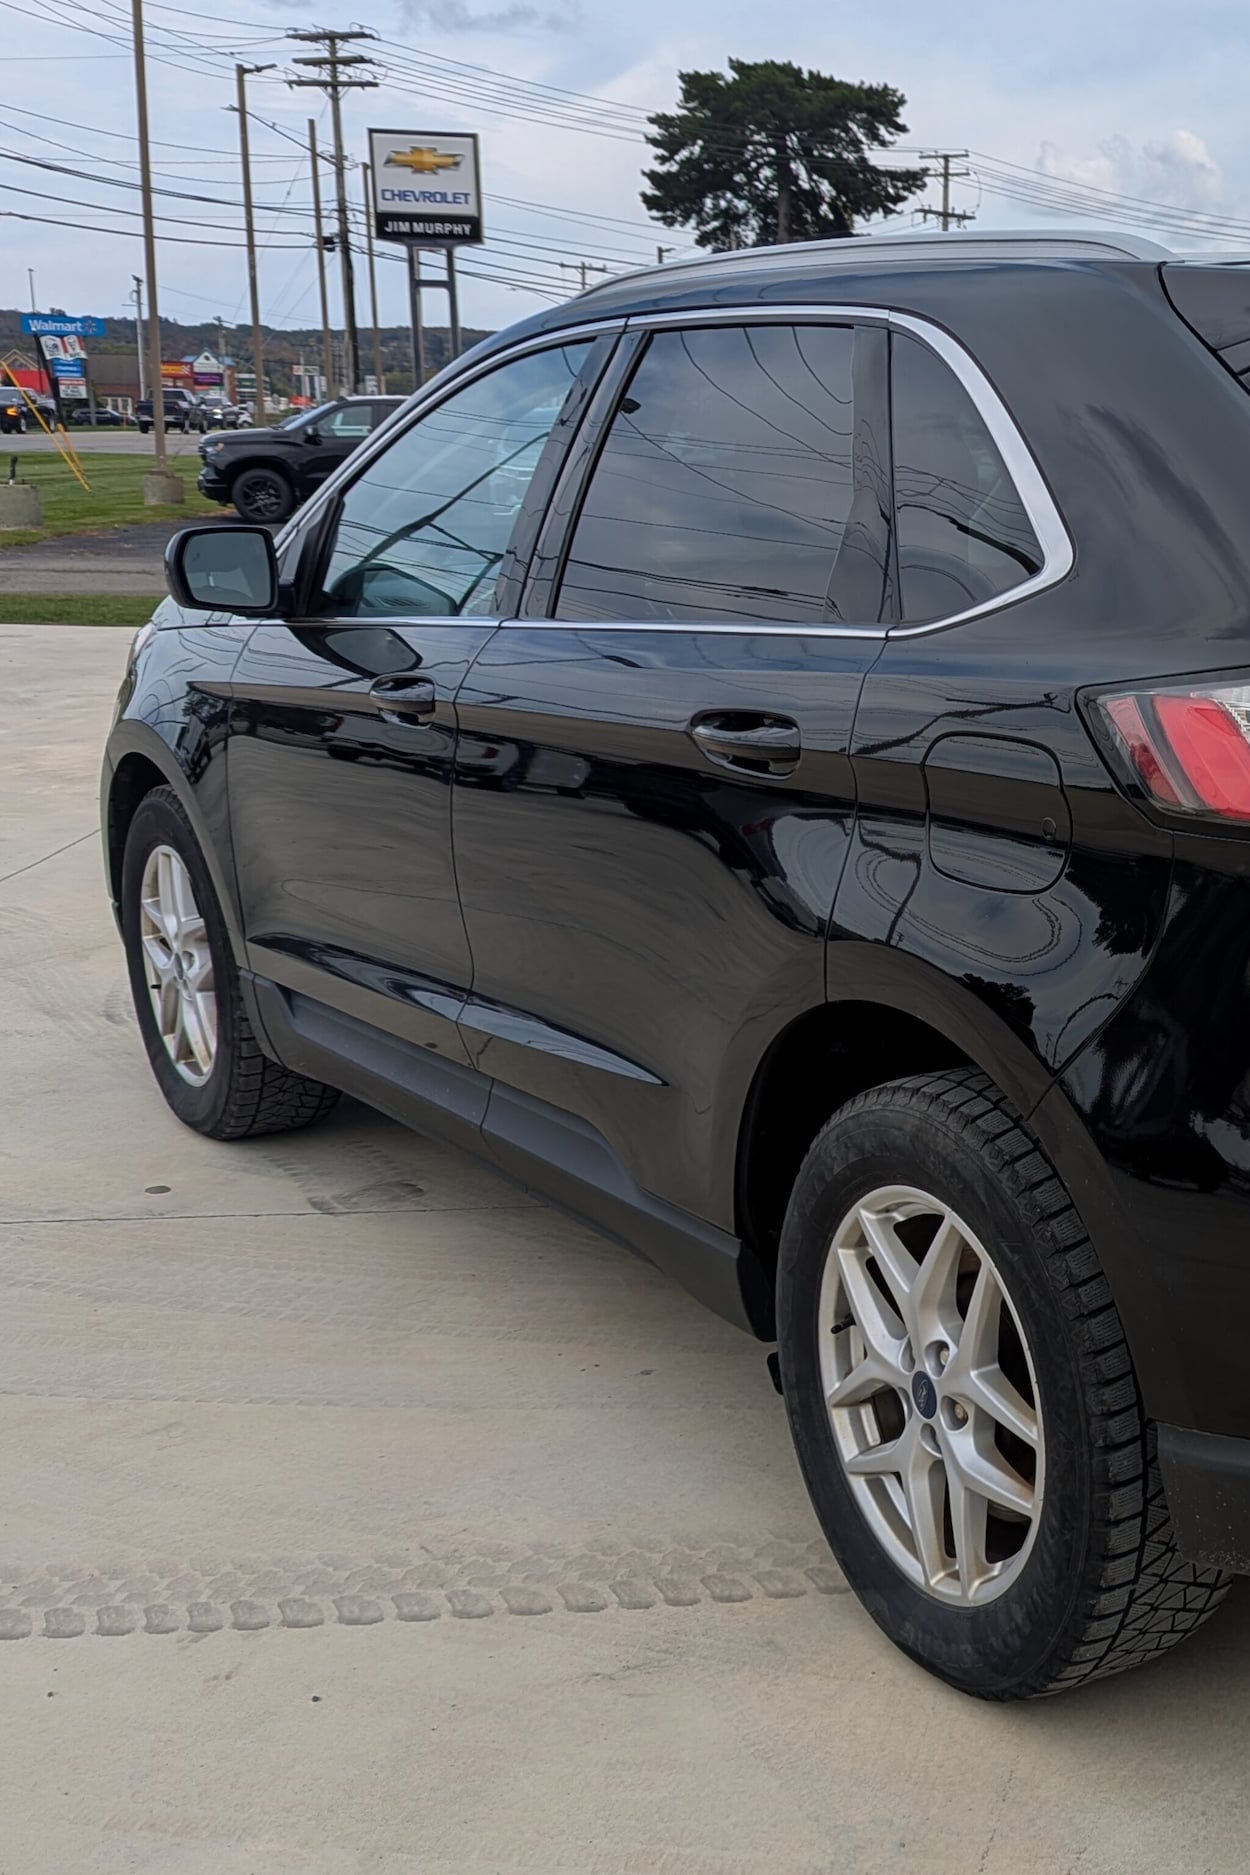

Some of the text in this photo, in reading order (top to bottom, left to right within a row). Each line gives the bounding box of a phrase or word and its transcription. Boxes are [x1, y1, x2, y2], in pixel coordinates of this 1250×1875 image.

[380, 188, 471, 205] CHEVROLET
[384, 220, 472, 236] JIM MURPHY
[28, 319, 83, 332] Walmart
